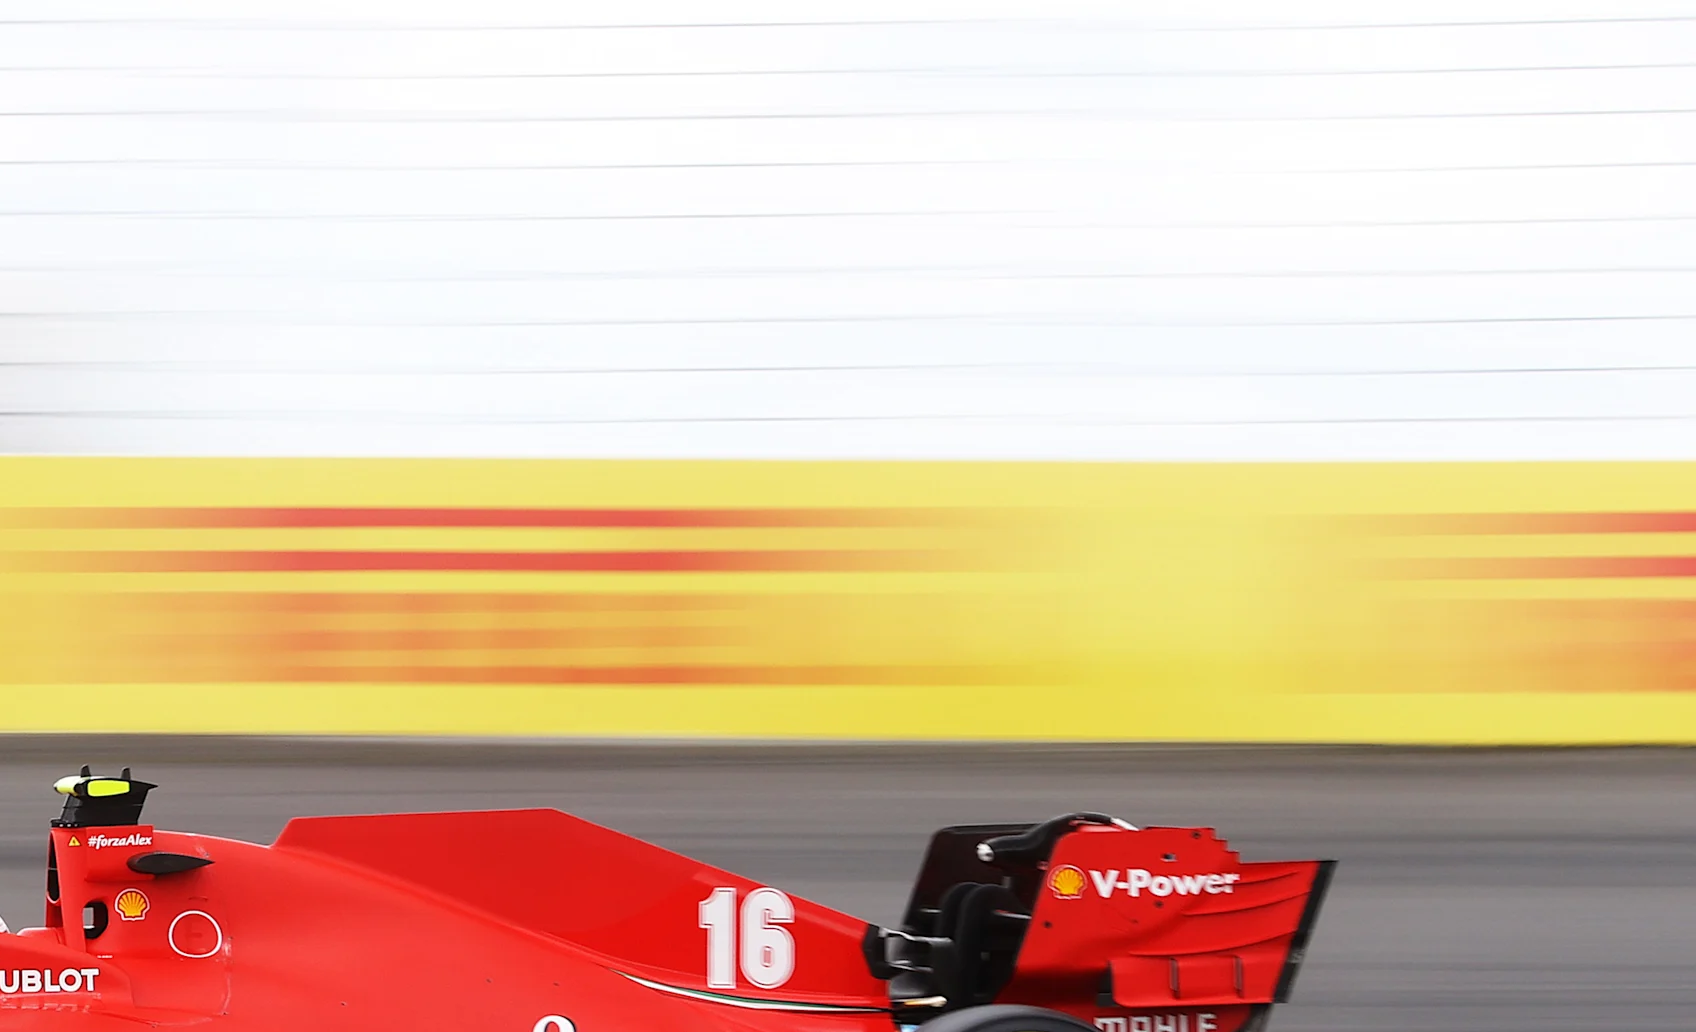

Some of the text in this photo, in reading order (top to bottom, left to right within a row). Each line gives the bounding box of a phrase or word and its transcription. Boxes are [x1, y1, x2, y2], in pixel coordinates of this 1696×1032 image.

[88, 833, 153, 850] #forzaAlex
[1088, 868, 1241, 899] V-Power
[698, 886, 796, 989] 16
